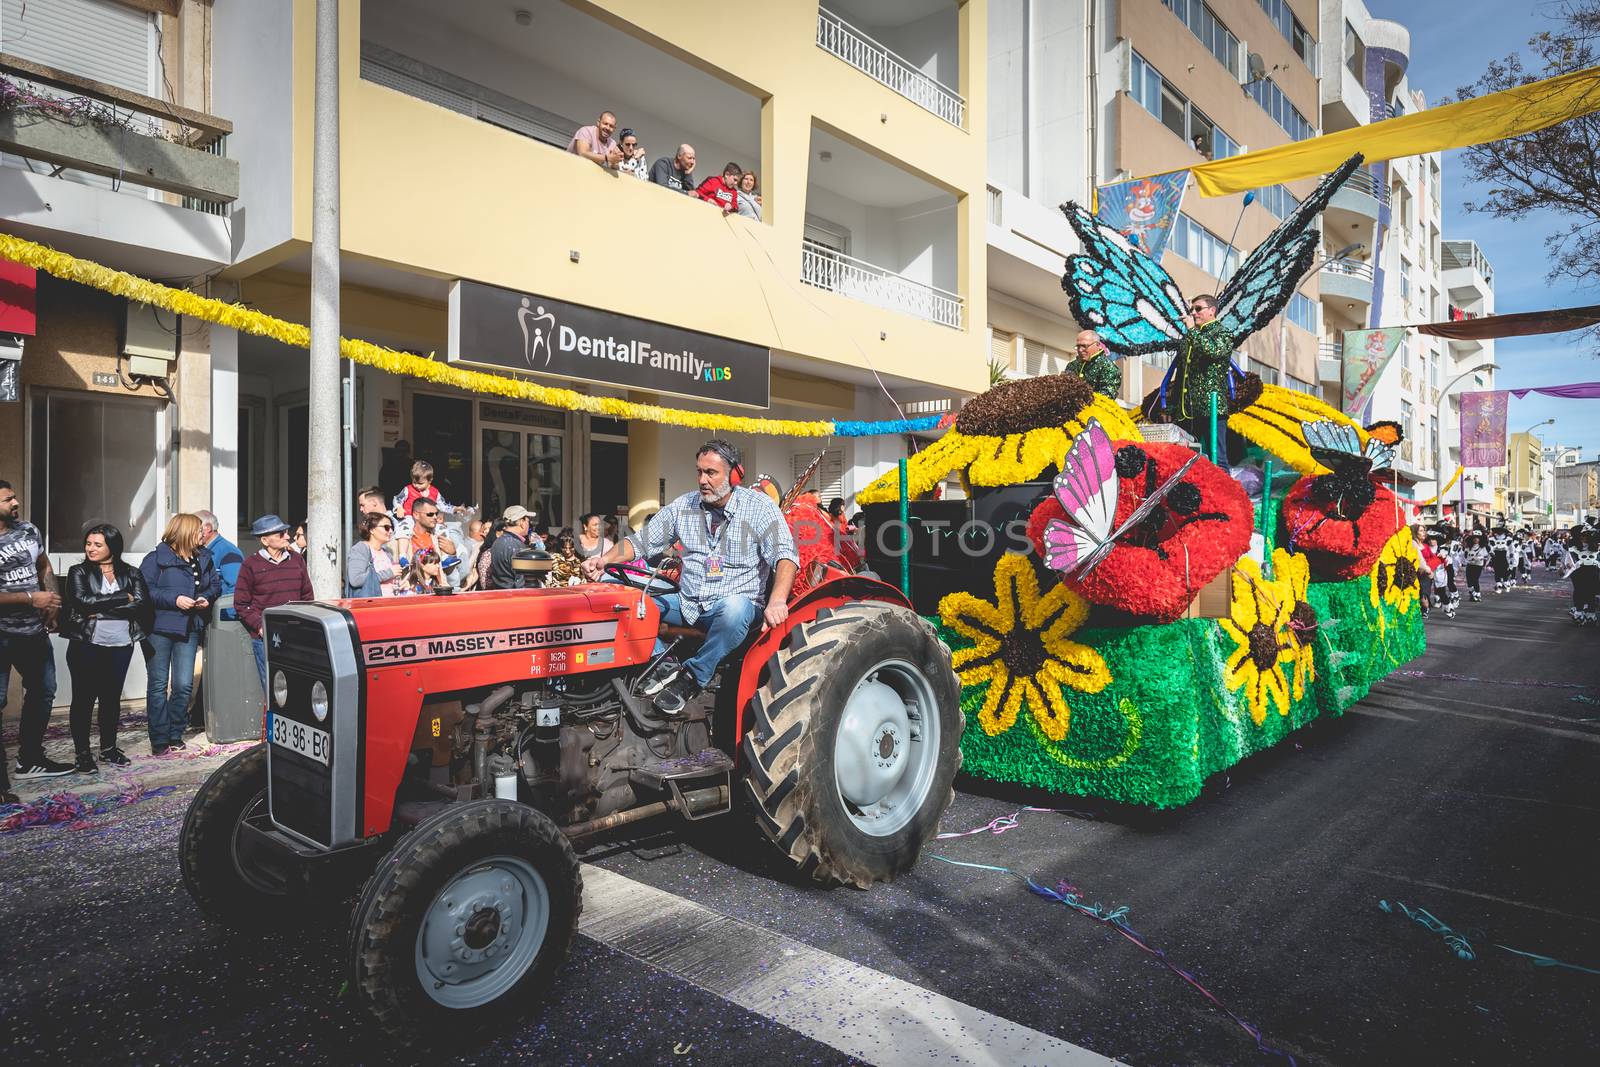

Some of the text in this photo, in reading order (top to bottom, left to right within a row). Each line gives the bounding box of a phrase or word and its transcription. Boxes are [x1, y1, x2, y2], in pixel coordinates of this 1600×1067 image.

[559, 325, 704, 380] DentalFamily
[704, 366, 732, 382] KIDS
[6, 567, 32, 581] LOCAL
[428, 636, 495, 655] MASSEY
[509, 628, 582, 647] FERGUSON
[368, 644, 417, 661] 240
[550, 652, 567, 662] 1626
[548, 663, 567, 673] 7500
